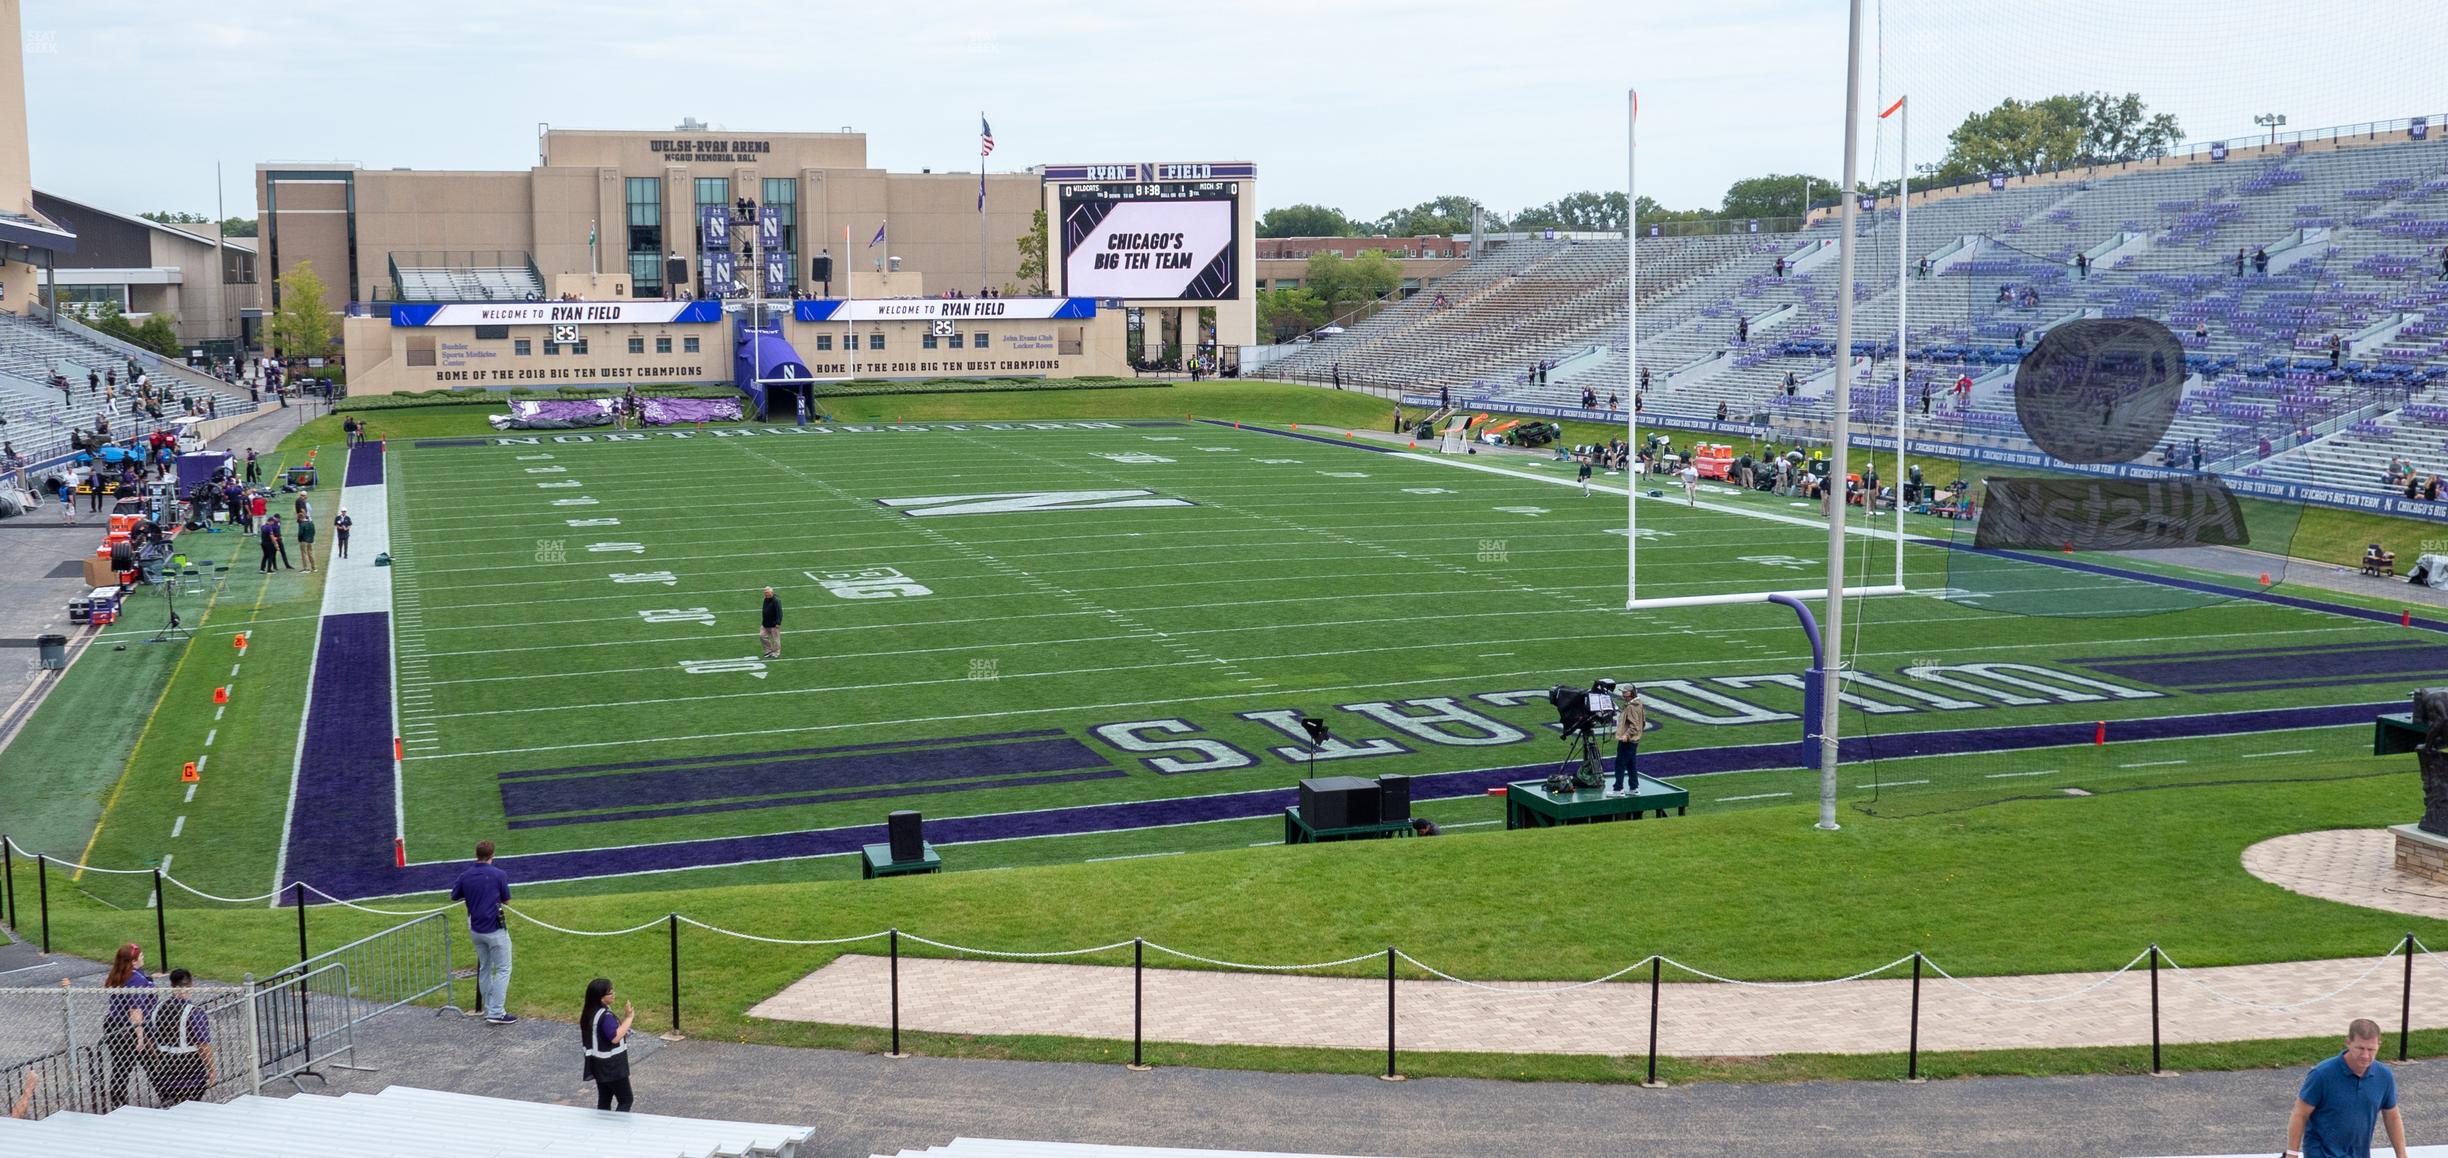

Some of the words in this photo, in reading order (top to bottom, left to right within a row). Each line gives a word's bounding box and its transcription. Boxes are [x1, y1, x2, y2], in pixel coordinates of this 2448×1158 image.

[2412, 124, 2425, 135] 107
[651, 140, 728, 152] WELSH-RYAN
[732, 141, 770, 153] ARENA
[696, 154, 735, 162] MEMORIAL
[737, 154, 757, 162] HALL
[1087, 166, 1126, 180] RYAN
[1167, 164, 1211, 179] FIELD
[1073, 184, 1100, 192] WILDCATS
[711, 217, 724, 237] N
[764, 217, 777, 237] N
[1108, 233, 1184, 250] CHICAGO'S
[1094, 253, 1120, 270] BIG
[1125, 253, 1150, 269] TEN
[1156, 252, 1193, 269] TEAM
[716, 262, 730, 283] N
[770, 263, 784, 283] N
[482, 310, 527, 319] WELCOME
[533, 310, 544, 318] TO
[552, 306, 583, 320] RYAN
[588, 306, 621, 320] FIELD
[878, 306, 920, 315] WELCOME
[925, 306, 935, 314] TO
[942, 303, 970, 316] RYAN
[975, 303, 1005, 316] FIELD
[556, 327, 576, 341] 25
[936, 321, 952, 335] 25
[437, 371, 468, 380] HOME
[473, 371, 487, 380] OF
[492, 370, 514, 379] THE
[519, 370, 545, 379] 2018
[551, 369, 569, 378] BIG
[574, 369, 596, 377] TEN
[601, 368, 633, 377] WEST
[638, 367, 702, 376] CHAMPIONS
[784, 365, 795, 379] N
[817, 364, 845, 373] HOME
[867, 364, 887, 372] THE
[892, 363, 916, 371] 2018
[921, 363, 938, 371] BIG
[943, 362, 963, 370] TEN
[968, 362, 996, 370] WEST
[1000, 361, 1059, 370] CHAMPIONS
[1982, 450, 2007, 461] CHICAGO'S
[2007, 453, 2016, 462] BIG
[2016, 454, 2026, 463] TEN
[2027, 455, 2040, 465] TEAM
[2044, 456, 2050, 467] N
[2100, 464, 2116, 474] TEAM
[2119, 465, 2126, 477] N
[2130, 467, 2158, 480] CHICAGO'S
[2242, 480, 2253, 491] BIG
[2254, 482, 2266, 493] TEN
[2266, 484, 2284, 495] TEAM
[2288, 484, 2295, 498] N
[2333, 492, 2344, 503] BIG
[2346, 493, 2359, 505] TEN
[2360, 495, 2379, 508] TEAM
[2384, 497, 2392, 511] N
[2397, 500, 2433, 516] CHICAGO'S
[2433, 505, 2447, 517] BIG
[638, 607, 716, 623] 20
[678, 656, 767, 674] 10
[184, 766, 192, 777] G
